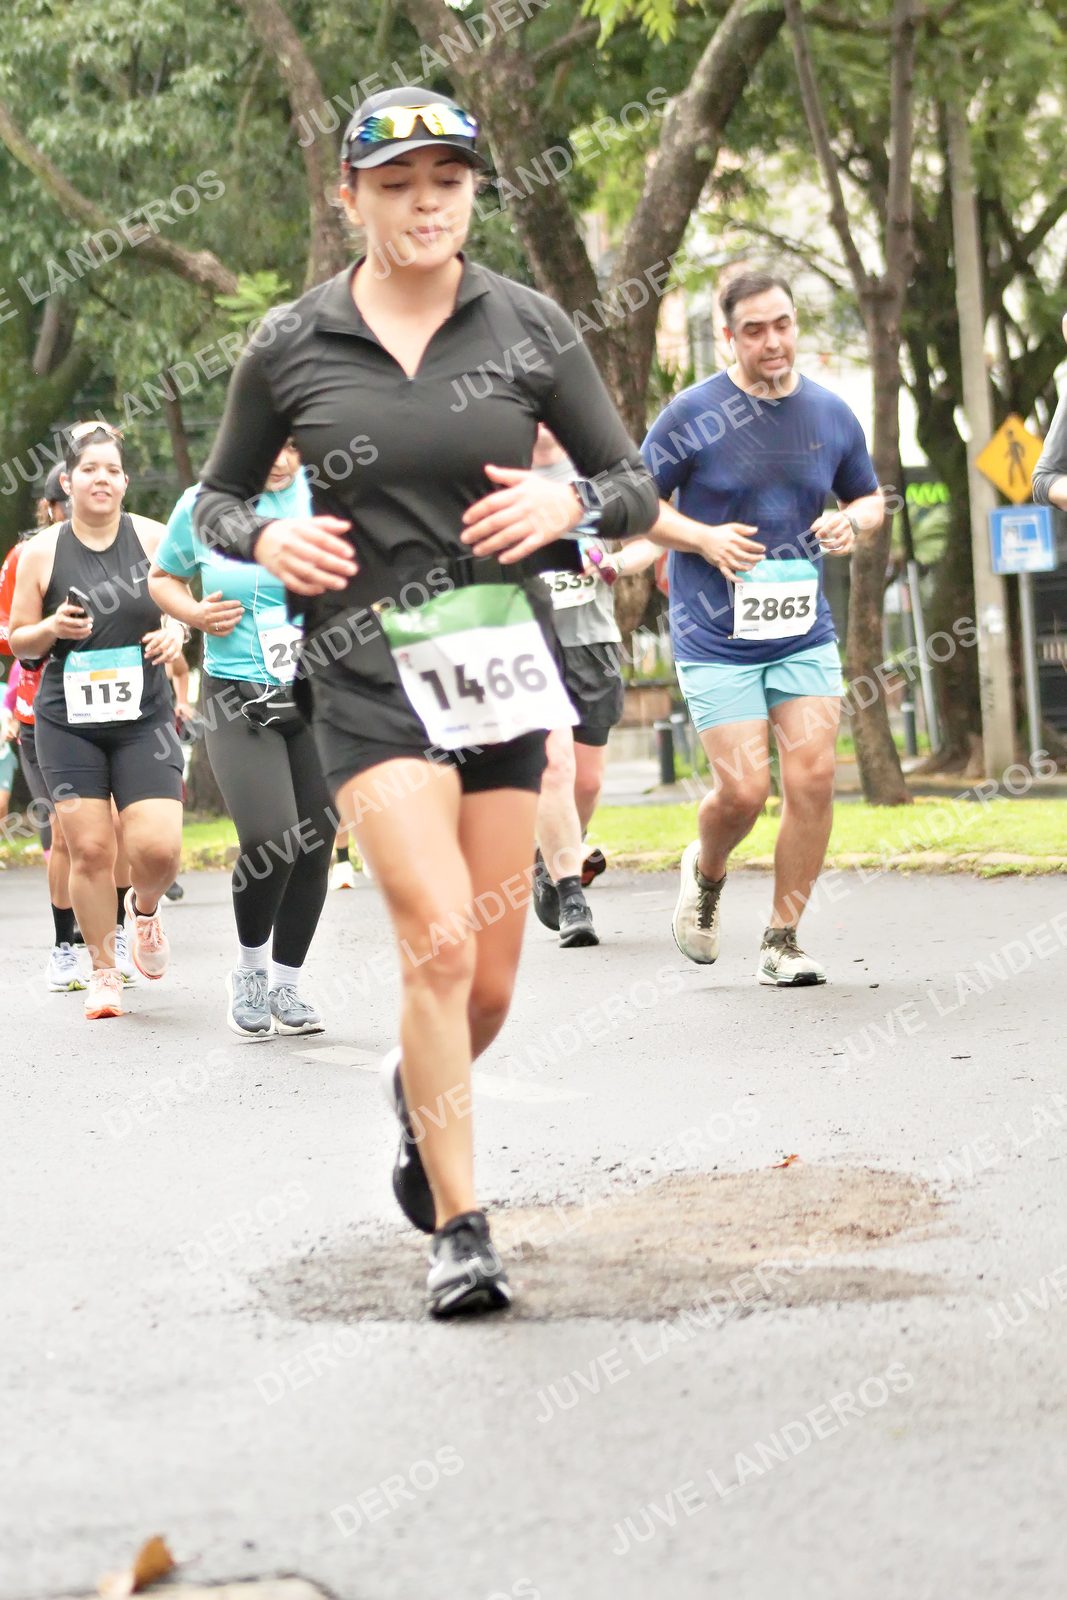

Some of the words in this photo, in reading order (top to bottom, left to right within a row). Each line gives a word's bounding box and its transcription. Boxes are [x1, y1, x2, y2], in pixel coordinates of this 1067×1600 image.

[742, 595, 811, 622] 2863
[81, 682, 132, 705] 113
[419, 653, 548, 711] 1466
